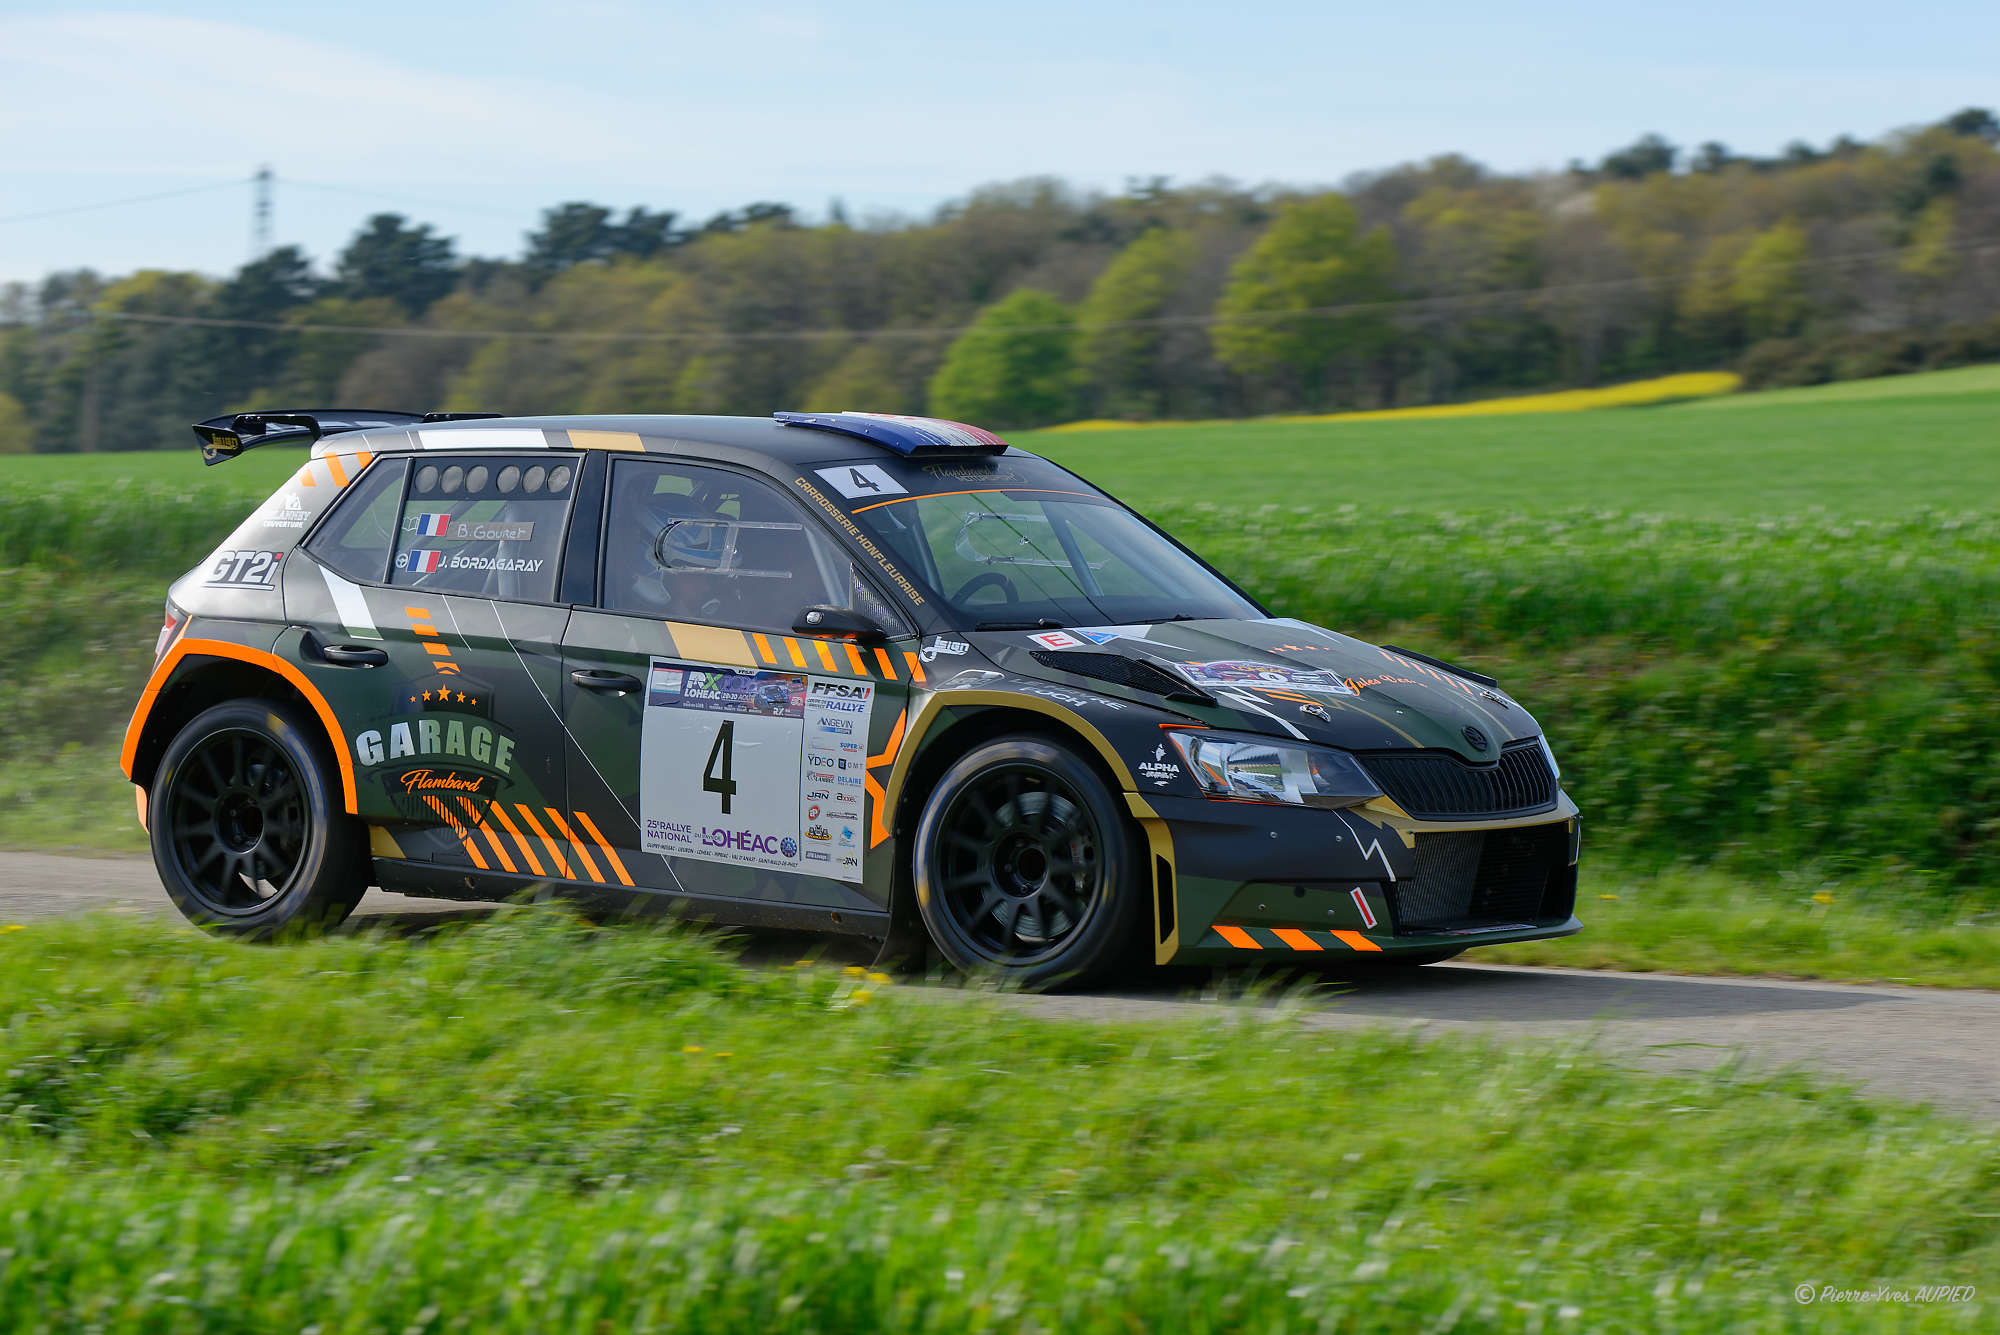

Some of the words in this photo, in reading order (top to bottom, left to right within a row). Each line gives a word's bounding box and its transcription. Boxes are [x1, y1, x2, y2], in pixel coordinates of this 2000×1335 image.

[849, 468, 880, 492] 4
[794, 476, 860, 537] CARROSSERIE
[855, 533, 926, 607] HONFLEURAISE
[208, 550, 285, 585] GT2i
[450, 556, 544, 573] BORDAGARAY
[684, 688, 721, 700] LOHEAC
[811, 682, 864, 699] FFSA
[825, 700, 865, 713] RALLYE
[817, 717, 854, 728] ANGEVIN
[355, 719, 516, 775] GARAGE
[702, 719, 737, 815] 4
[1138, 761, 1180, 773] ALPHA
[400, 769, 484, 794] Flambard
[660, 821, 692, 834] RALLYE
[647, 829, 692, 844] NATIONAL
[702, 827, 778, 855] LOHÉAC
